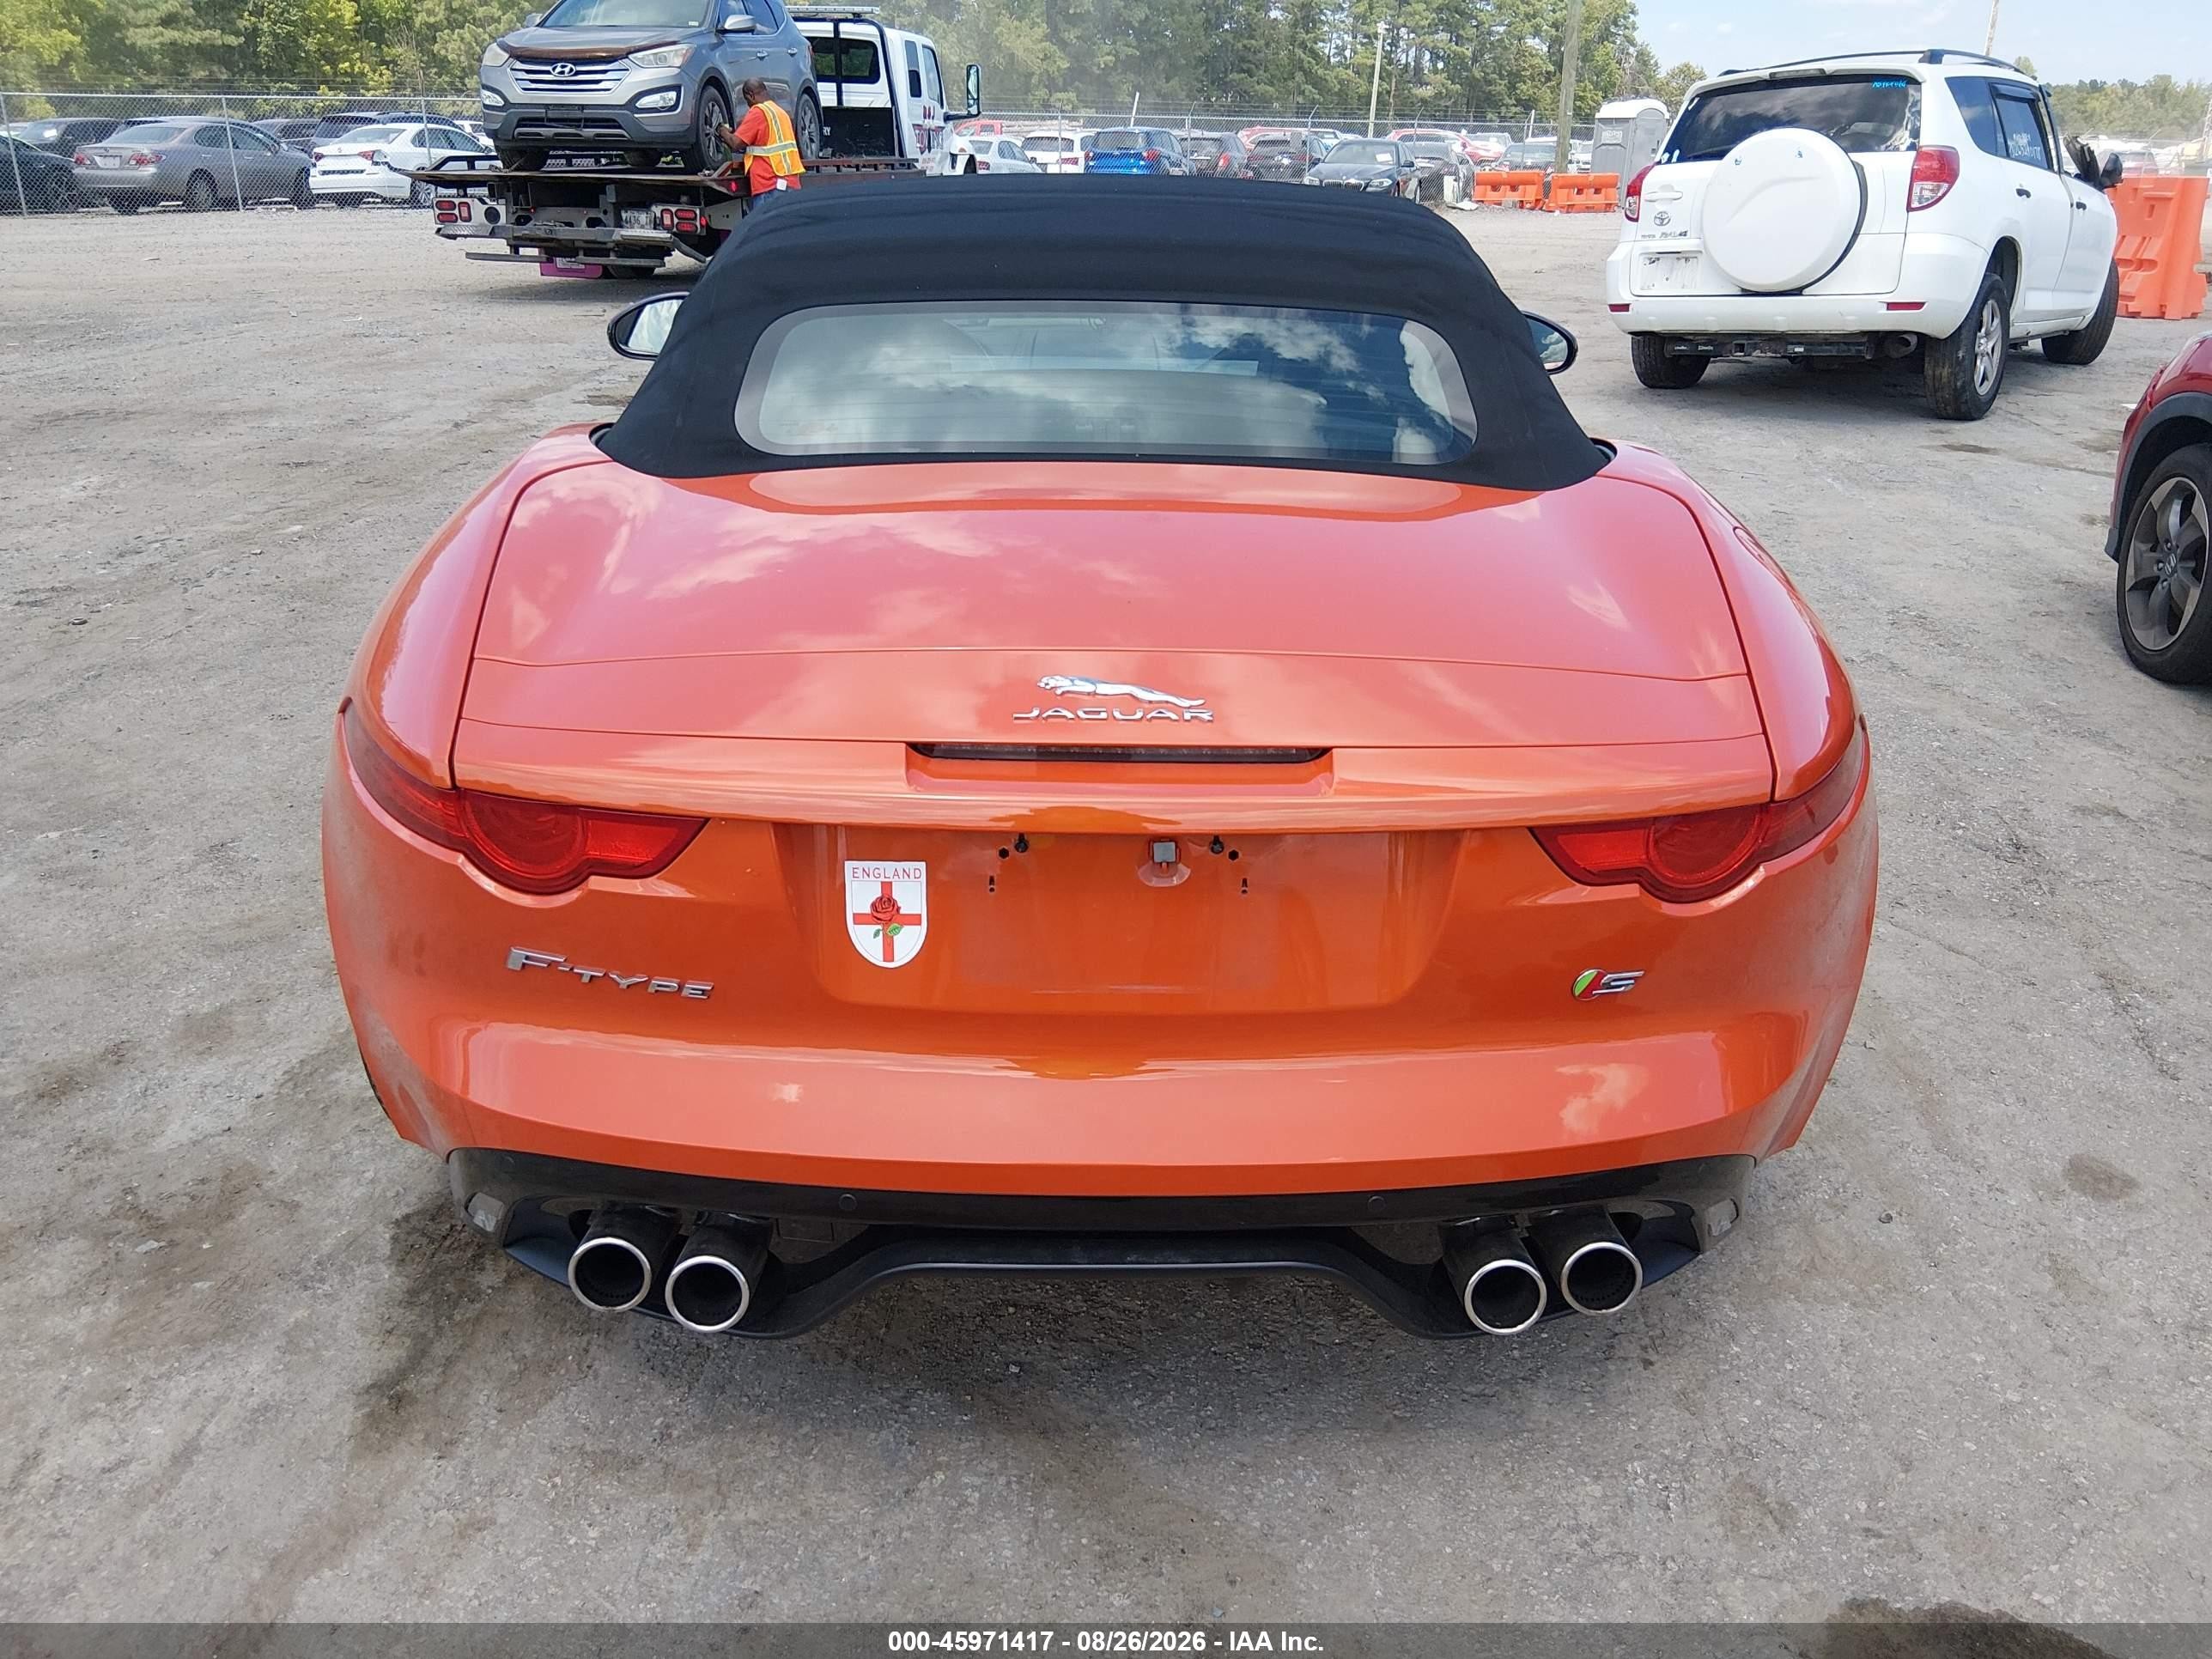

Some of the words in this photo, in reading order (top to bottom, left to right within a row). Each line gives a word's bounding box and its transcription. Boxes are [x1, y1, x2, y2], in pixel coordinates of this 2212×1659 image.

[1012, 707, 1214, 722] JAGUAR
[852, 866, 922, 880] ENGLAND
[507, 946, 714, 1000] F-TYPE
